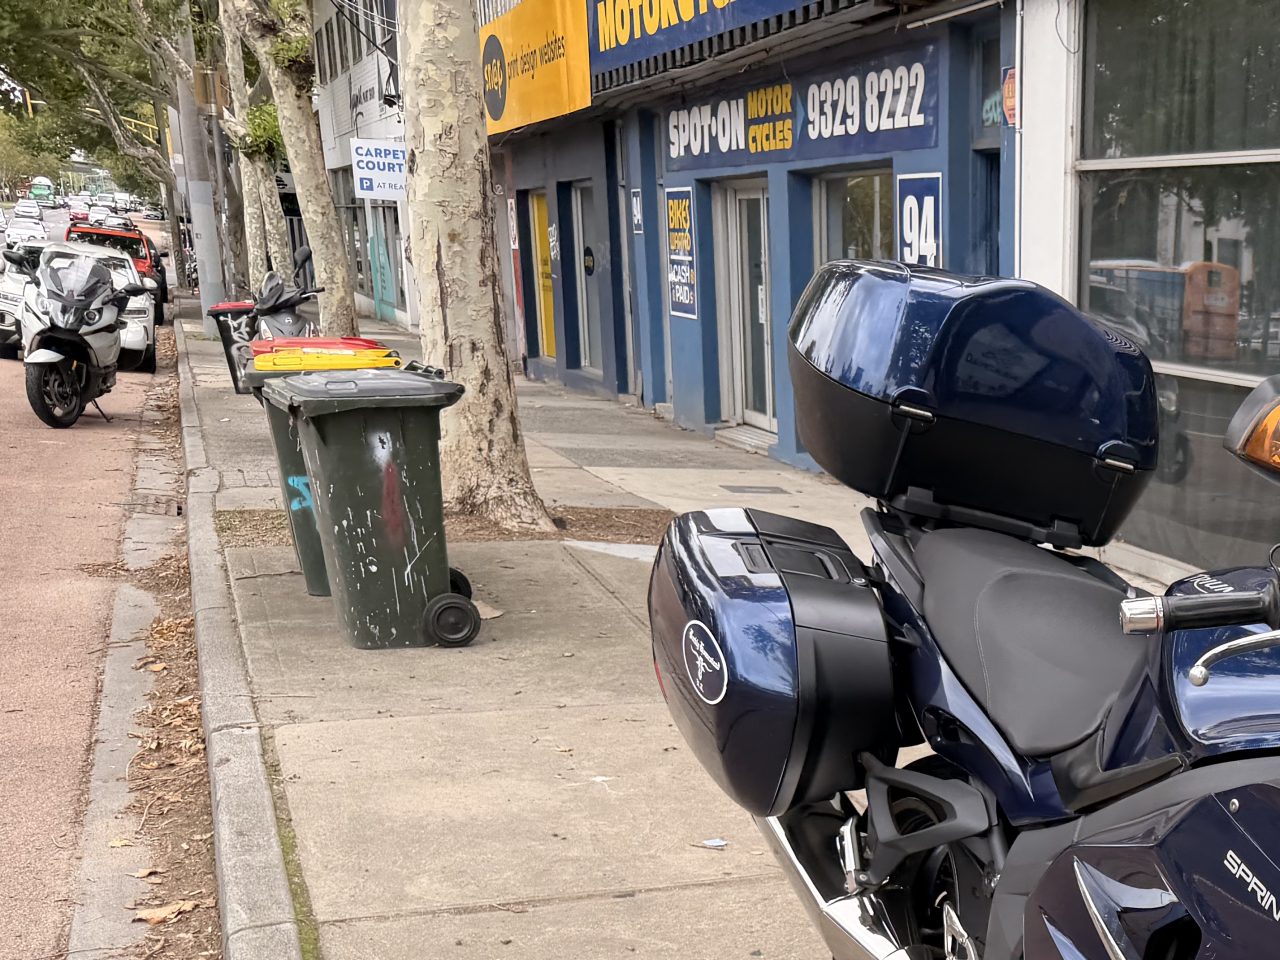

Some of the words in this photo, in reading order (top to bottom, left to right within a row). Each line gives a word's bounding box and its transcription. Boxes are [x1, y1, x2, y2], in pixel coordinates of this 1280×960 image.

[507, 52, 520, 88] print
[520, 44, 538, 79] design
[539, 30, 566, 67] websites
[747, 83, 793, 119] MOTOR
[807, 76, 860, 140] 9329
[865, 62, 925, 133] 8222
[749, 119, 793, 153] CYCLES
[355, 146, 406, 160] CARPET
[356, 160, 404, 173] COURT
[376, 182, 387, 190] AT
[668, 198, 690, 230] BIKES
[903, 195, 937, 268] 94
[673, 264, 690, 284] CASH
[675, 284, 690, 304] PAID
